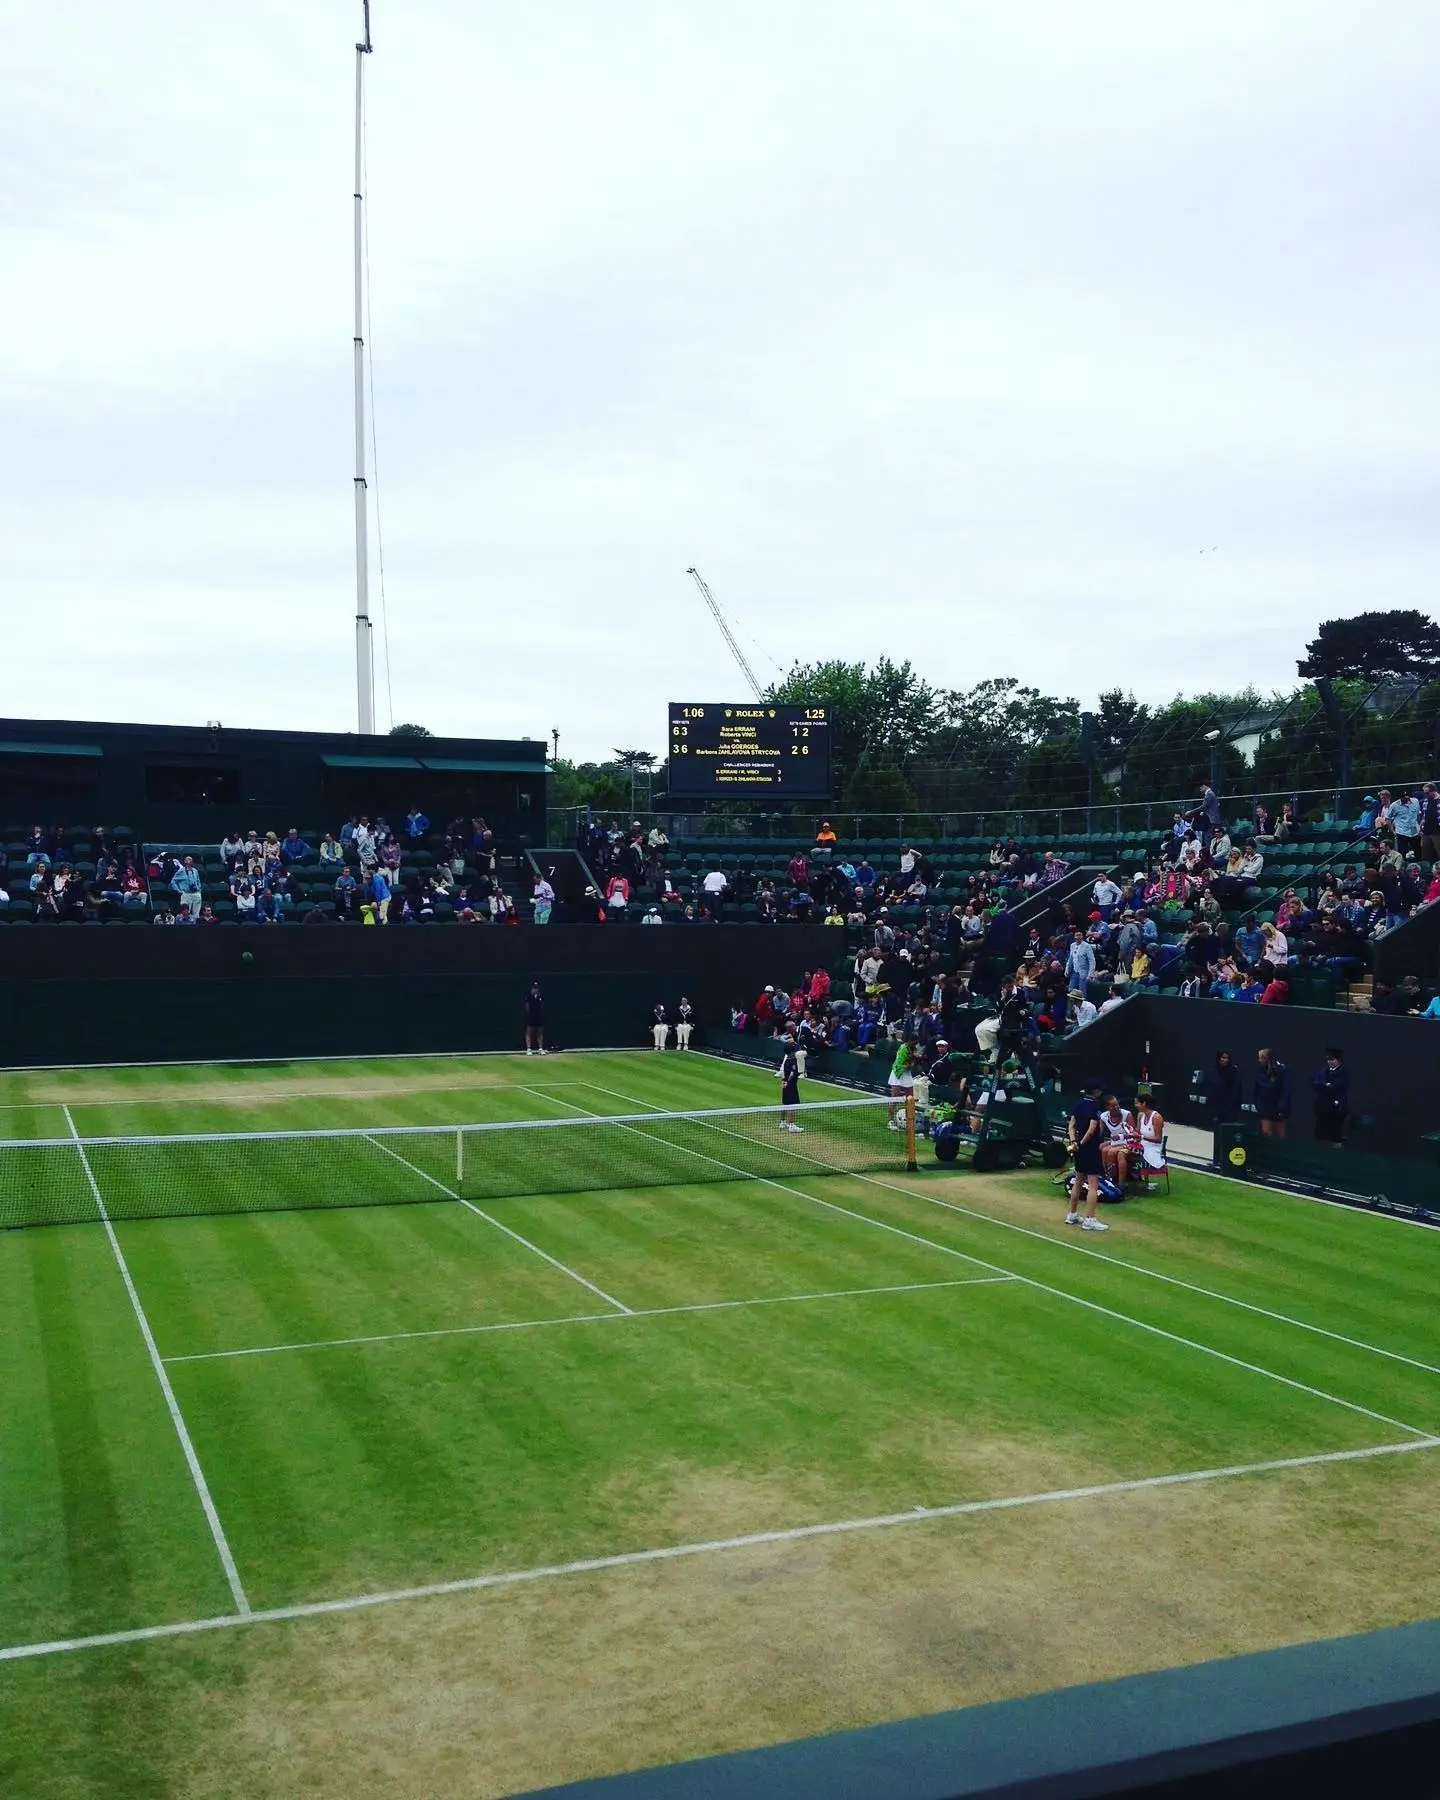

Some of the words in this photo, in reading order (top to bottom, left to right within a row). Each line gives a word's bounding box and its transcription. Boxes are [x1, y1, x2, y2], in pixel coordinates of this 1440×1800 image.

[682, 707, 705, 718] 1.06
[804, 708, 825, 719] 1.25
[672, 726, 680, 736] 6
[681, 726, 688, 736] 3
[792, 727, 798, 736] 1
[802, 727, 809, 736] 2
[672, 744, 680, 754] 3
[681, 744, 688, 754] 6
[791, 745, 798, 755] 2
[802, 745, 809, 755] 6
[549, 866, 556, 876] 7
